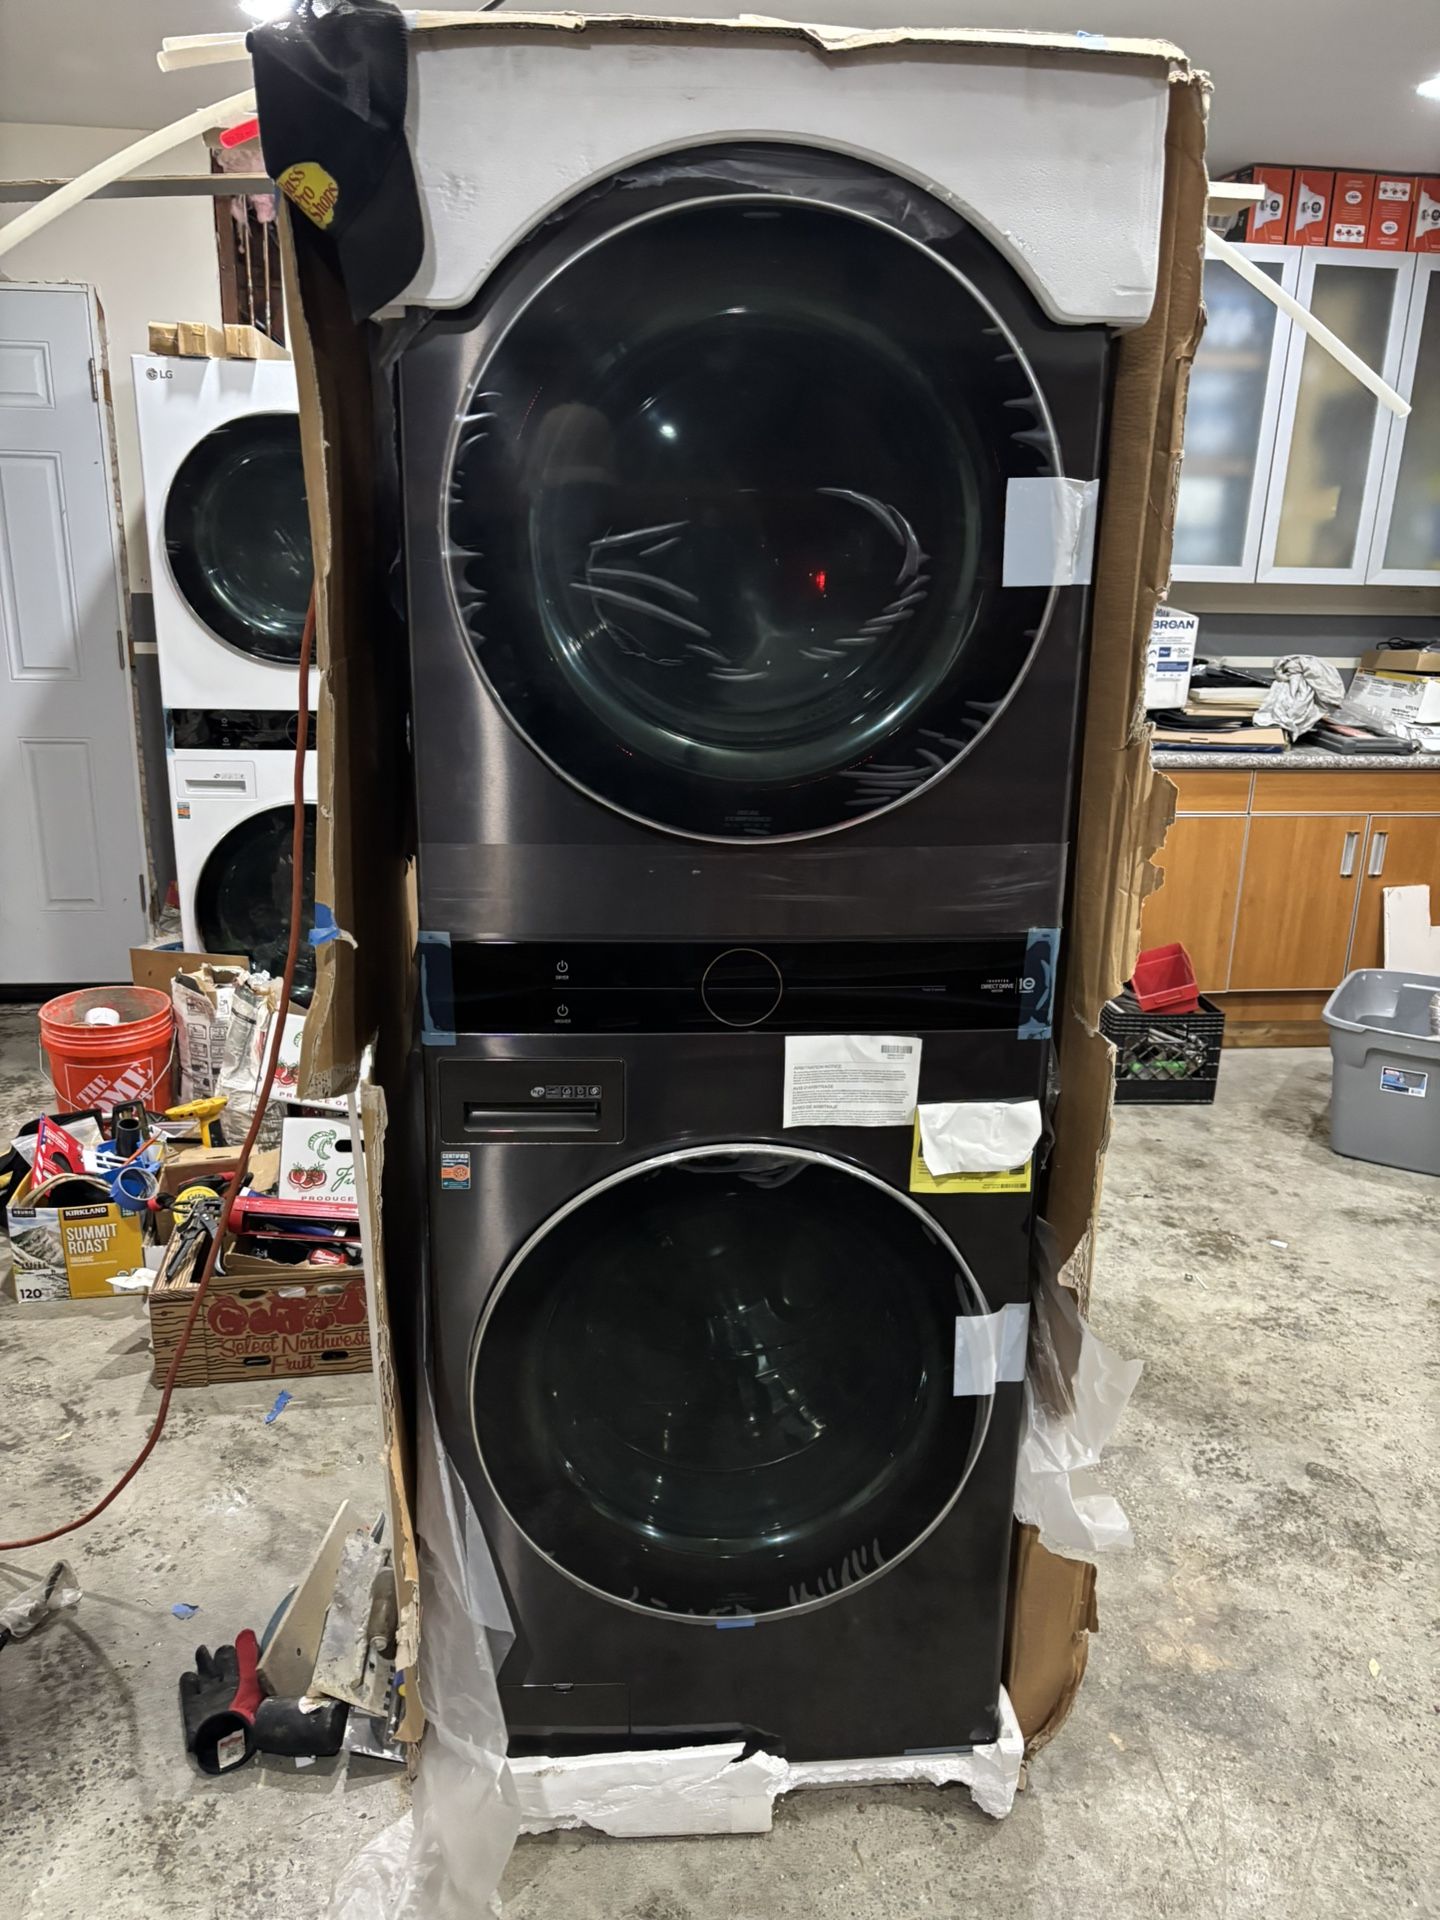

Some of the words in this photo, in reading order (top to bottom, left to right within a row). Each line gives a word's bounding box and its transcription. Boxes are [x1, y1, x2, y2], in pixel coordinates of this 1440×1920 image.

[279, 167, 306, 194] ass
[159, 369, 174, 379] LG
[1152, 619, 1195, 630] BROAN
[76, 1074, 112, 1106] THE
[90, 1062, 153, 1114] OME
[301, 1195, 355, 1203] PRODUCE
[64, 1206, 107, 1217] KIRKLAND
[65, 1223, 118, 1241] SUMMIT
[67, 1238, 110, 1256] ROAST
[20, 1288, 43, 1300] 120
[219, 1336, 279, 1358] Select
[281, 1330, 369, 1354] Northwest
[270, 1355, 317, 1373] Fruit
